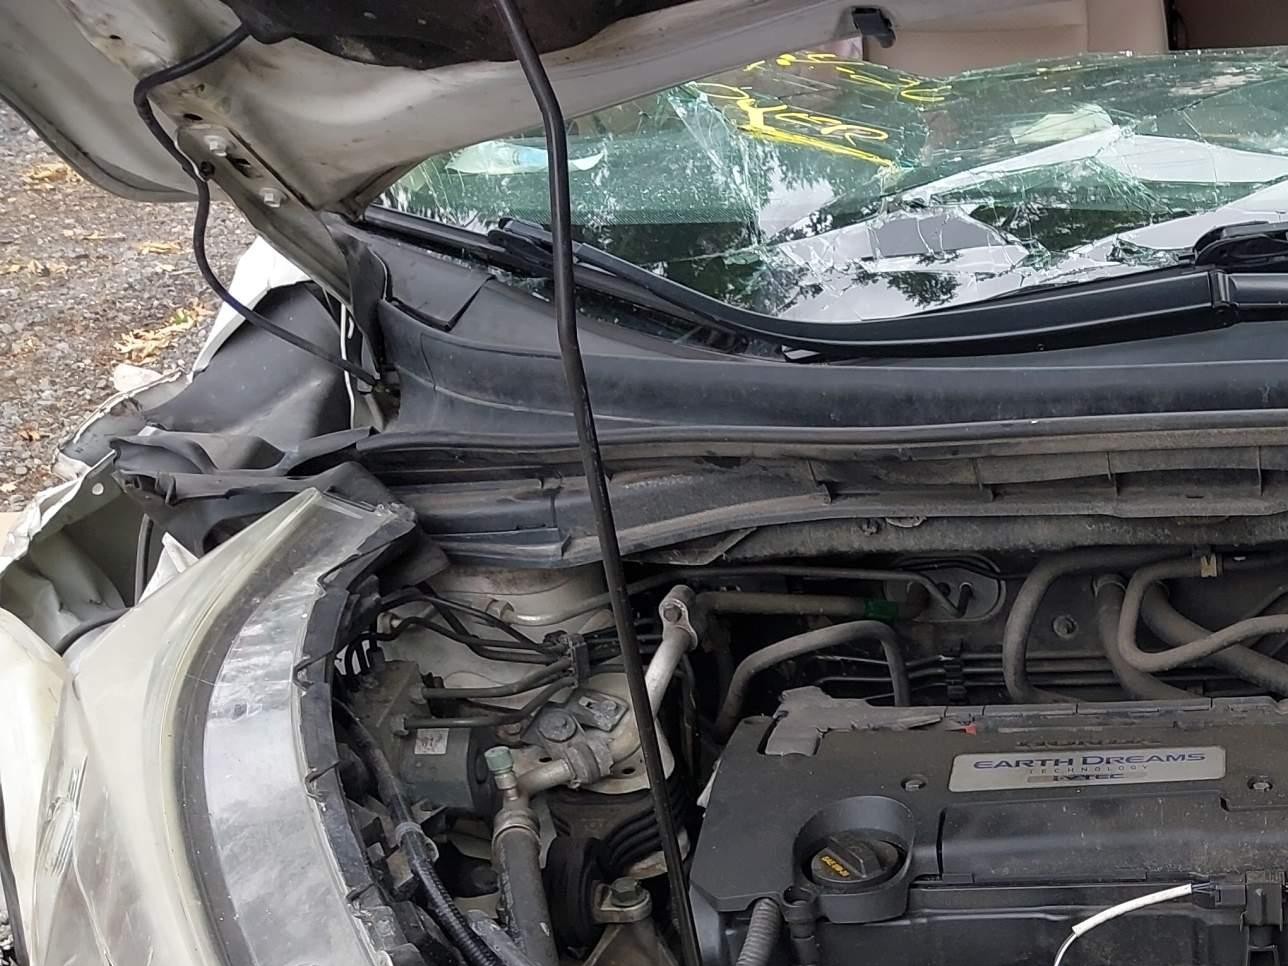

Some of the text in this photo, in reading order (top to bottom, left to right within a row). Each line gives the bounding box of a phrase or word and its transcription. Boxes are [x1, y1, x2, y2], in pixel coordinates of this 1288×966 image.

[973, 752, 1207, 770] EARTH DREAMS
[1029, 764, 1148, 775] TECHNOLOGY
